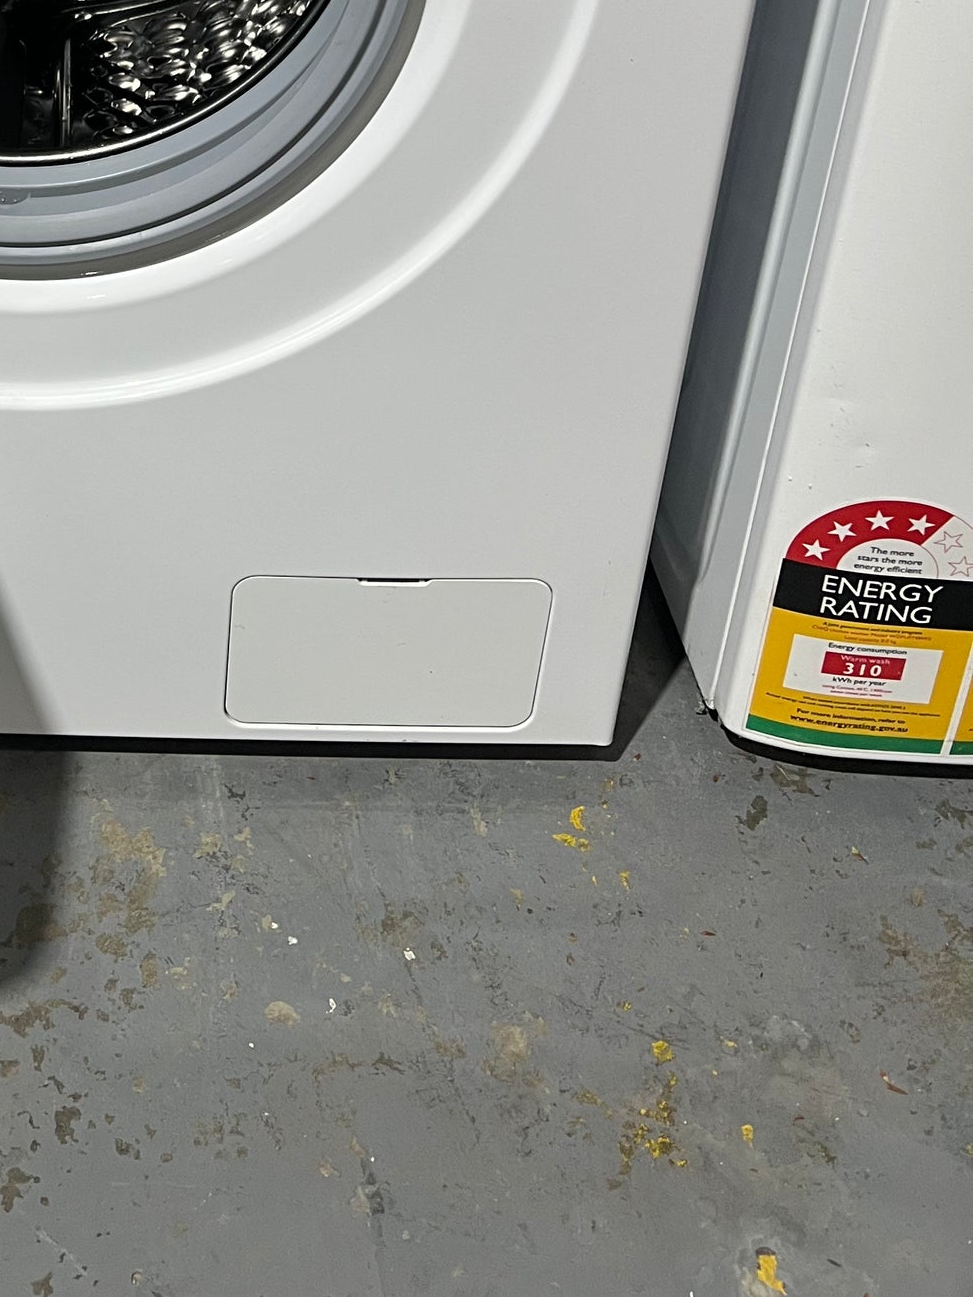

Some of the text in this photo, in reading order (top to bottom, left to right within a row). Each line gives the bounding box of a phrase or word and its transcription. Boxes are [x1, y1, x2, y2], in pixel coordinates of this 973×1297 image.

[870, 546, 888, 555] The
[857, 555, 879, 563] stars
[881, 556, 896, 564] the
[853, 563, 923, 575] energy efficient
[821, 574, 943, 603] ENERGY
[819, 596, 933, 625] RATING
[828, 642, 908, 655] Energy consumption
[840, 654, 868, 663] Warm
[842, 662, 883, 677] 310
[832, 676, 853, 684] kWh
